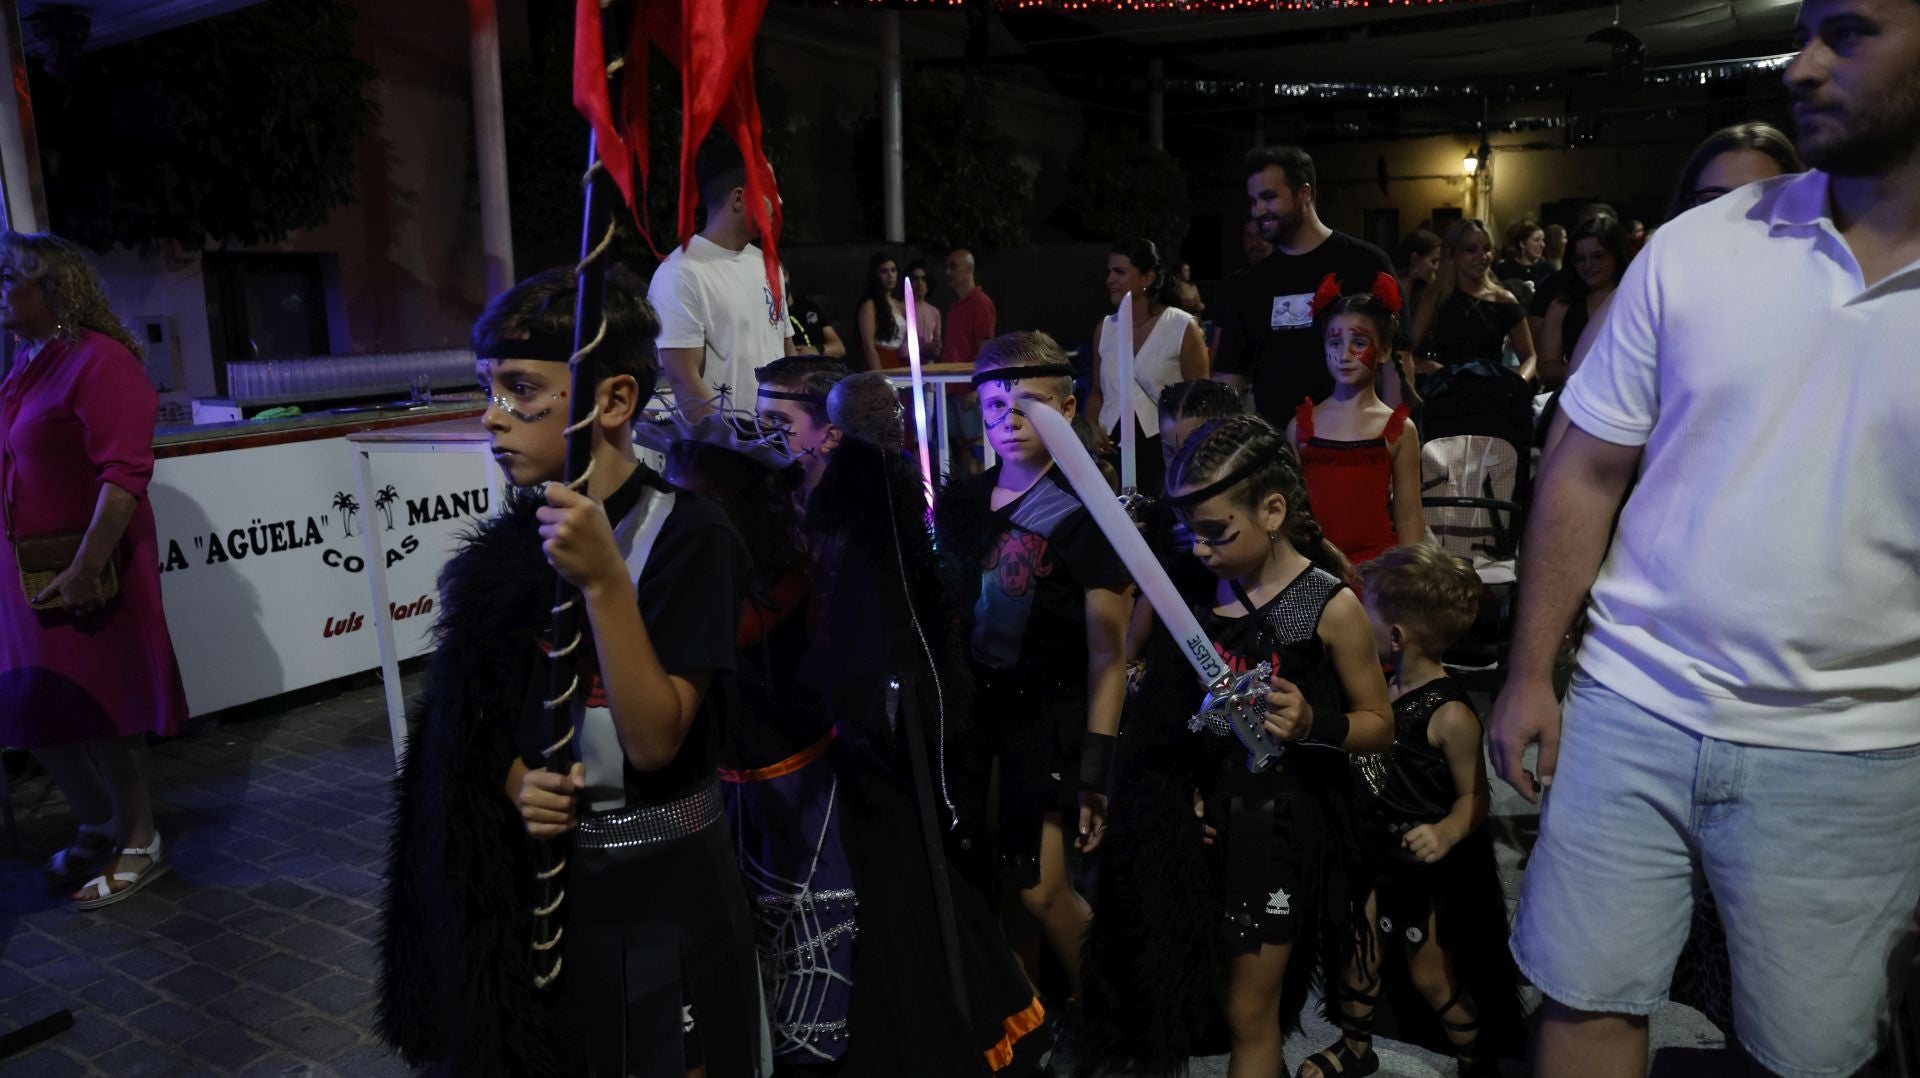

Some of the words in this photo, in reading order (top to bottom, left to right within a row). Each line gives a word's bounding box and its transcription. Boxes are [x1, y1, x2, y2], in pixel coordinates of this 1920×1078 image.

[194, 514, 329, 565] "AGÜELA"
[406, 487, 489, 526] MANU
[322, 534, 419, 573] COAS
[323, 611, 364, 638] Luis
[1186, 634, 1221, 678] CELESTE
